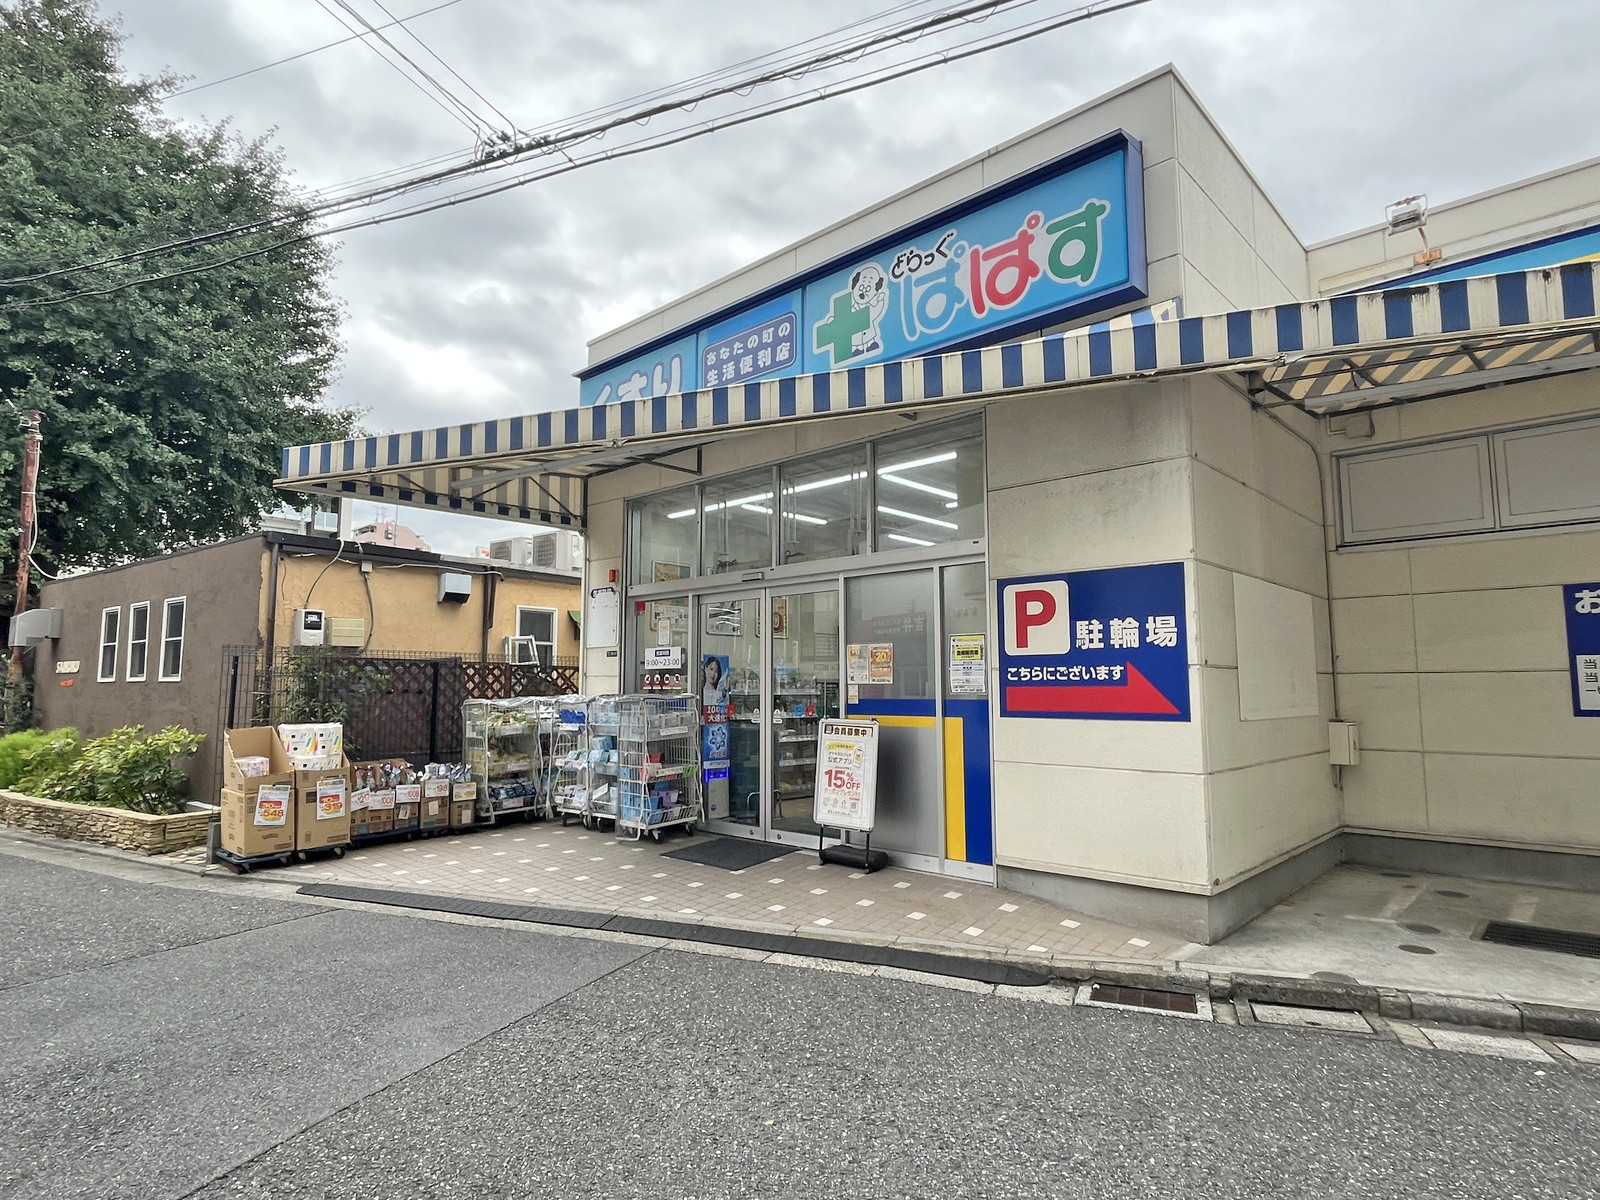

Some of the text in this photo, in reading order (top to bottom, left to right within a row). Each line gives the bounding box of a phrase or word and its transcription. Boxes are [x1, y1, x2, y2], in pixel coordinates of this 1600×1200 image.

[891, 232, 954, 279] どらっぐ
[903, 201, 1108, 340] ぱぱす
[706, 321, 791, 366] あなたの町の
[706, 342, 791, 387] 生活便利店
[1015, 589, 1057, 649] P
[1075, 615, 1178, 650] 駐輪場
[1007, 664, 1125, 681] こちらにございます
[263, 809, 284, 817] 548
